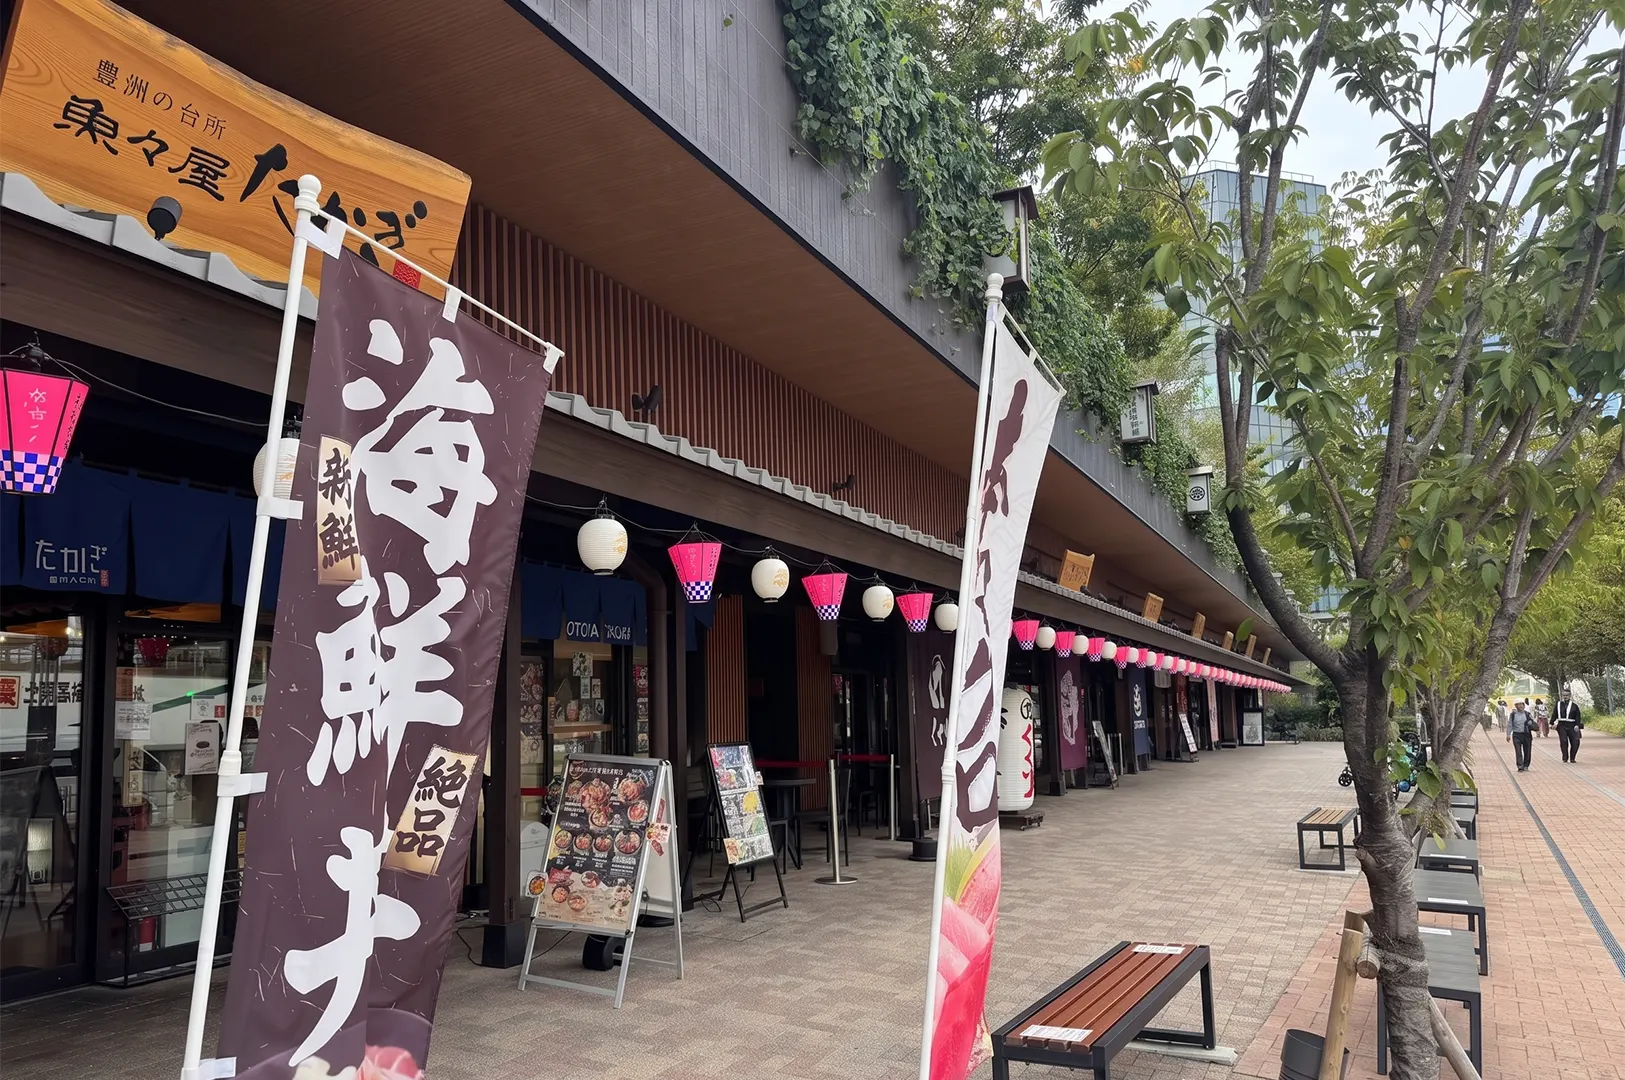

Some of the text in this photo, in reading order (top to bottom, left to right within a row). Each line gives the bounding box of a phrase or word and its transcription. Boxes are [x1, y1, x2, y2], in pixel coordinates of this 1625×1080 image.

[95, 58, 228, 141] 豊洲の台所
[318, 447, 359, 571] 新鮮
[35, 540, 108, 573] たかぎ
[395, 755, 469, 859] 絶品
